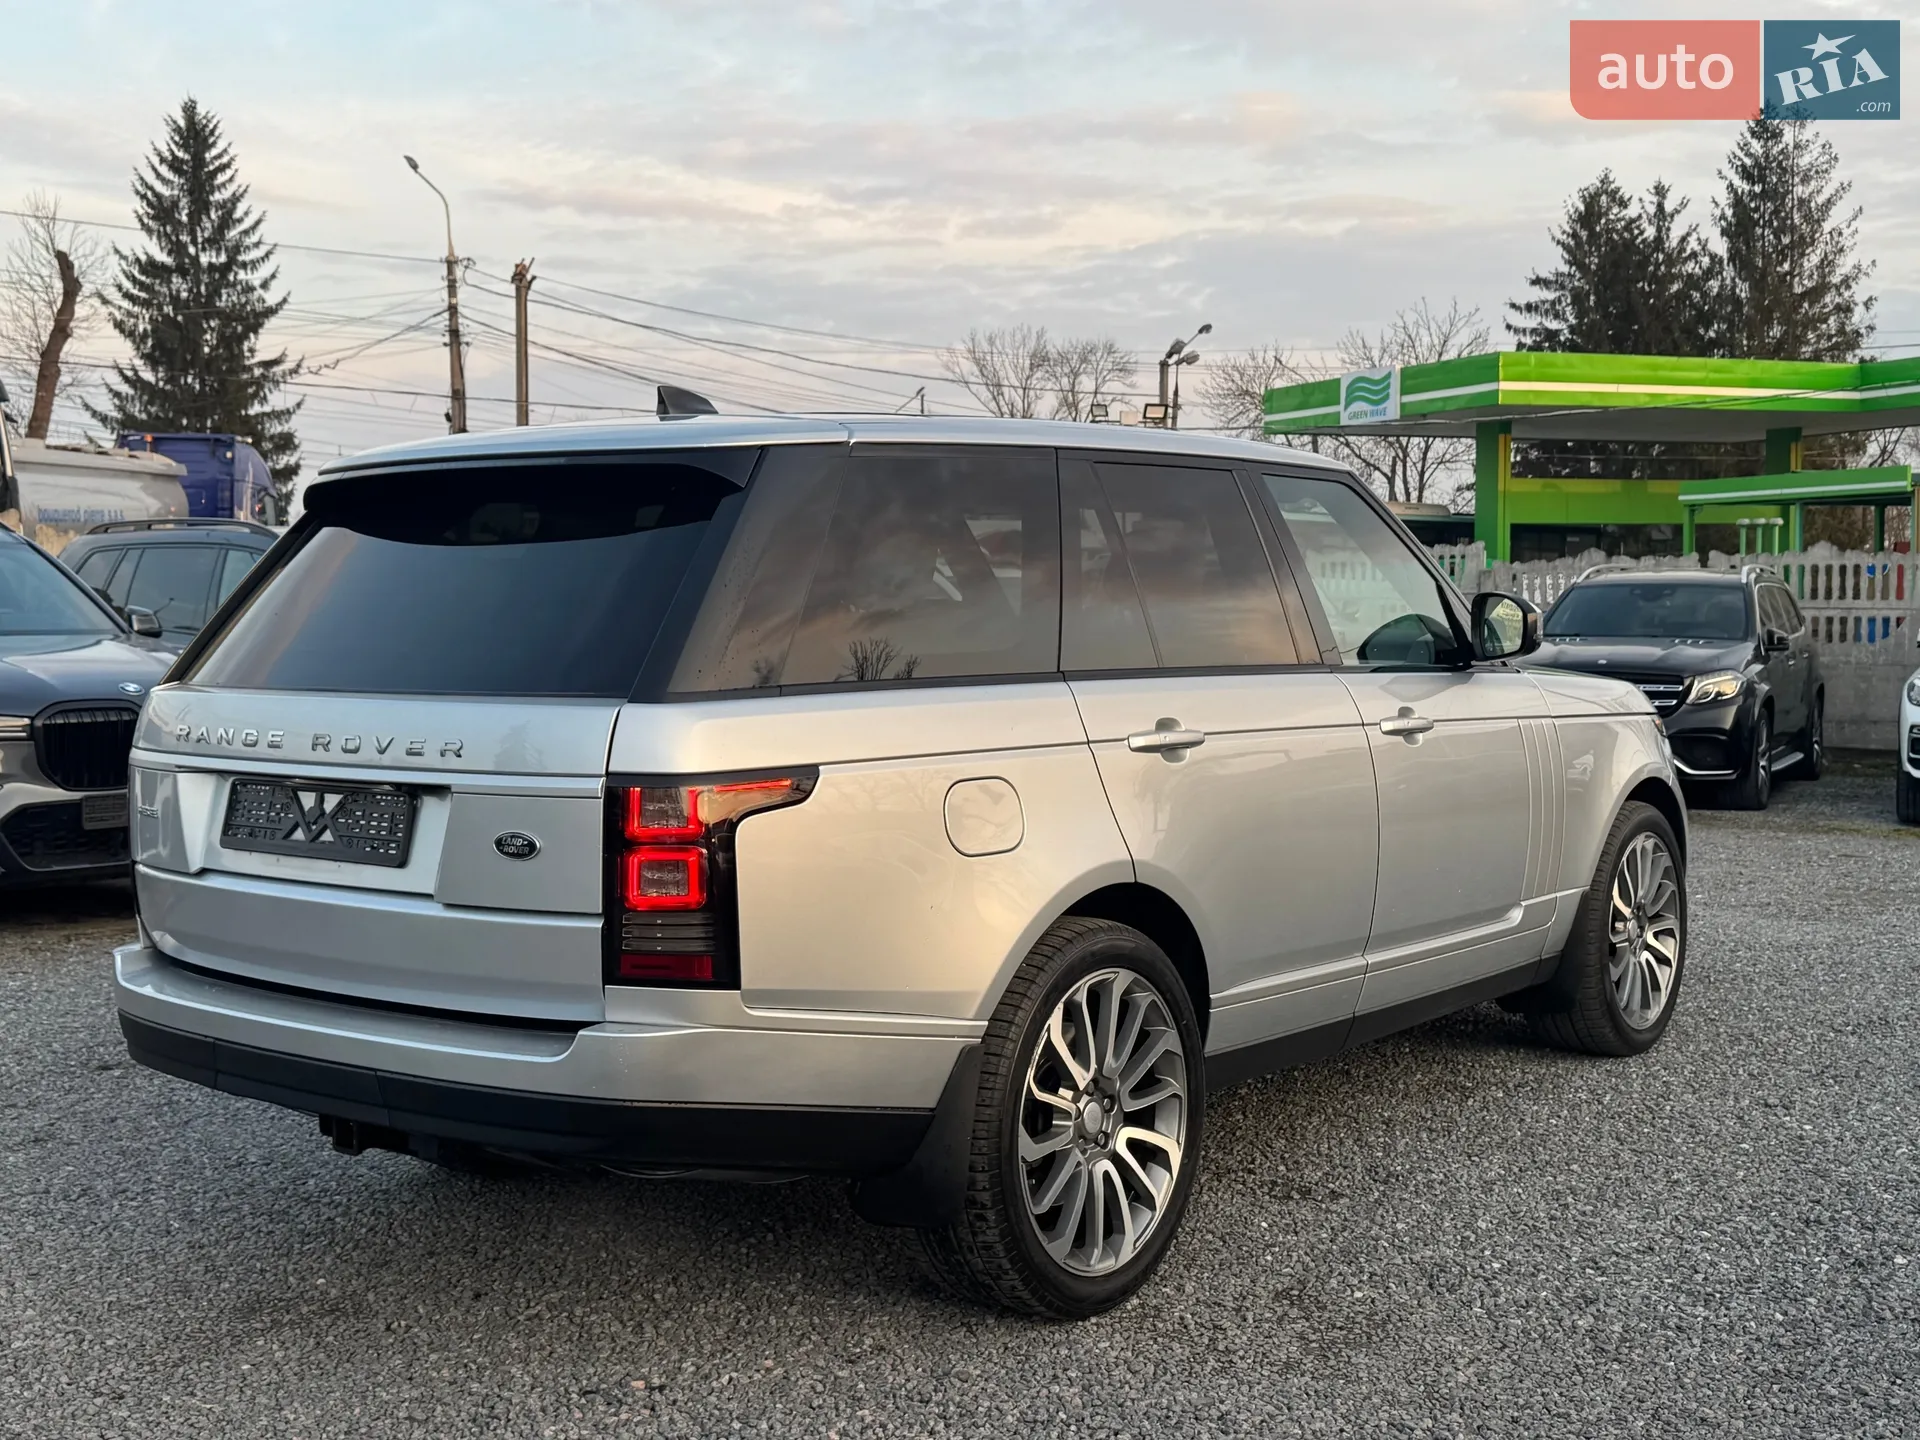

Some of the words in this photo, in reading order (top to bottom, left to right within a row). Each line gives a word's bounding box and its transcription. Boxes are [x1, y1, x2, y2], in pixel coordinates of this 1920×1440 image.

[1348, 410, 1369, 420] GREEN
[1370, 407, 1387, 417] WAVE
[175, 724, 285, 749] RANGE
[311, 733, 464, 758] ROVER
[501, 836, 523, 846] LAND
[503, 845, 530, 855] ROVER
